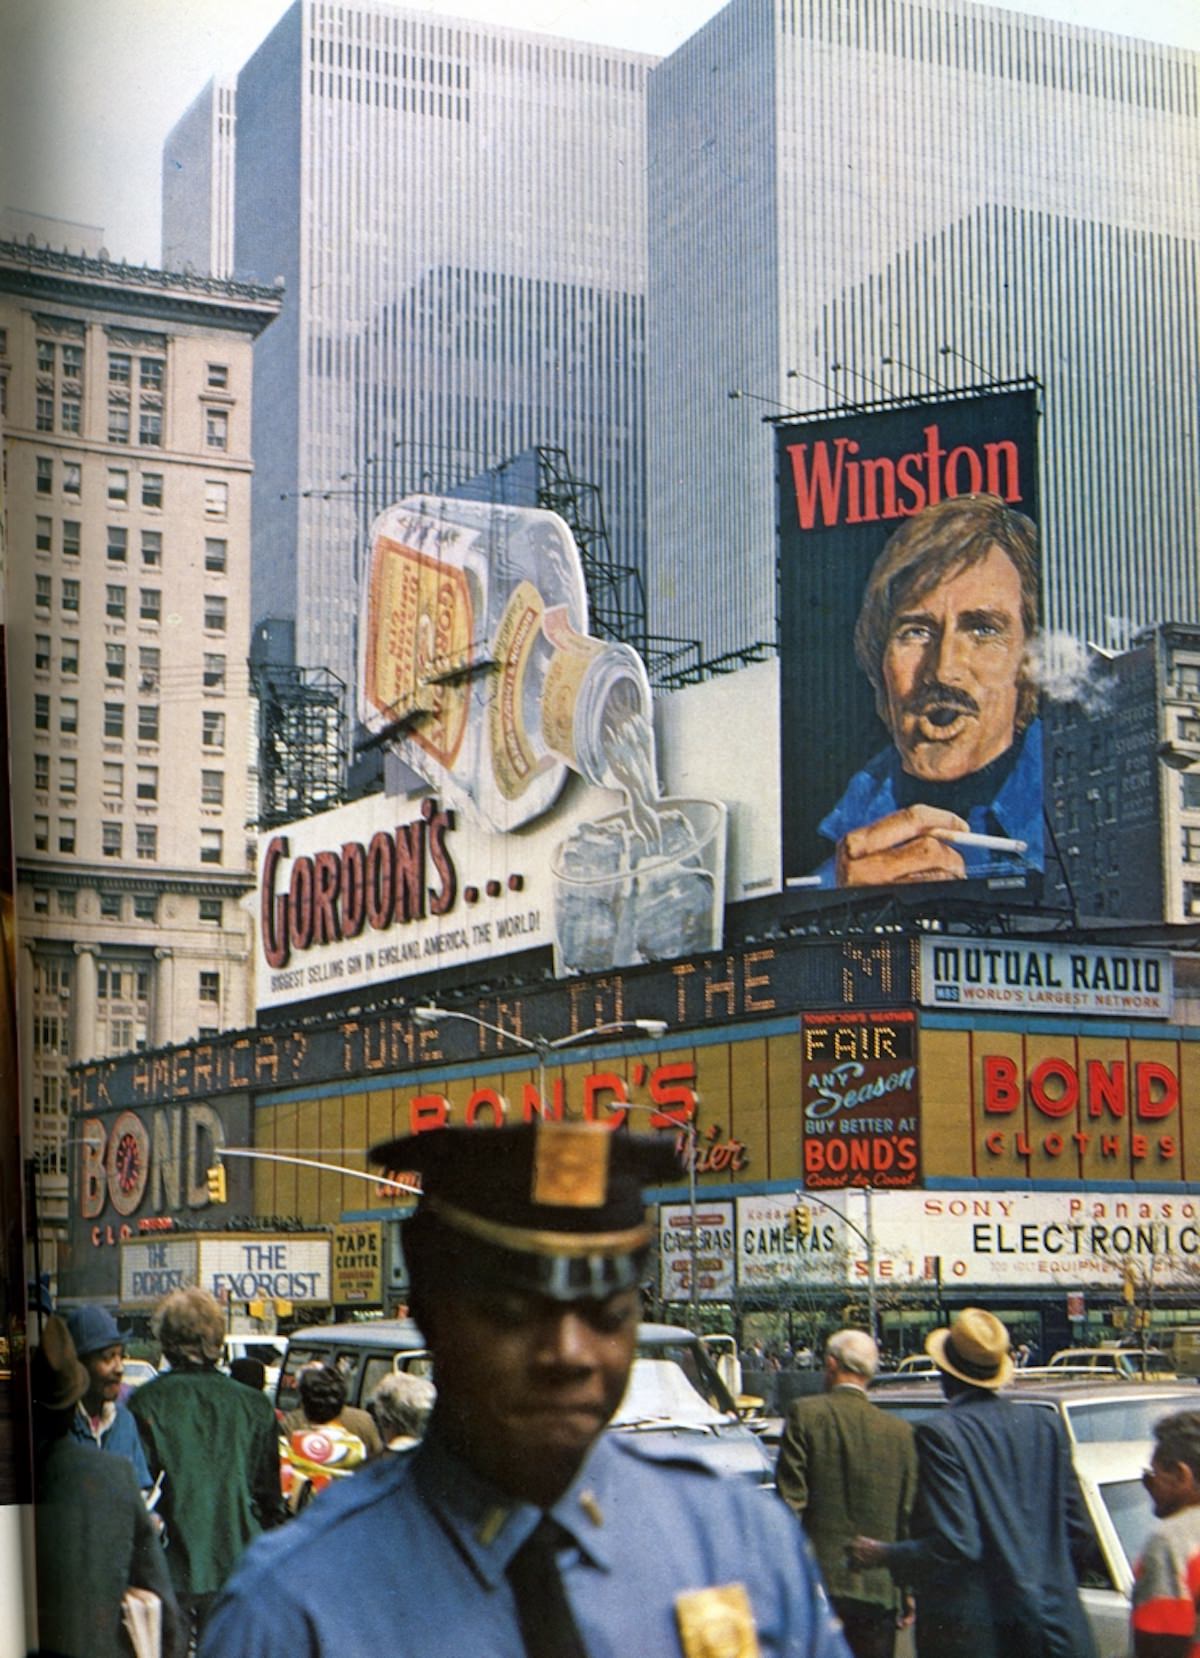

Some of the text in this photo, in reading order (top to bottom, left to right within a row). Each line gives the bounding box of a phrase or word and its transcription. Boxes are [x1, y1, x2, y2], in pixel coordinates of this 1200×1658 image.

[786, 423, 1022, 530] Winston
[270, 969, 305, 993] BIGGEST
[308, 959, 344, 985] SELLING
[347, 954, 363, 976] GIN
[365, 952, 375, 972] IN
[472, 922, 492, 945] THE
[497, 910, 541, 940] WORLD!
[933, 946, 1161, 993] MUTUAL RADIO
[339, 1017, 444, 1073] TUNE
[671, 948, 776, 1023] THE
[963, 985, 1025, 1002] WORLD'S
[1028, 991, 1091, 1007] LARGEST
[1095, 995, 1161, 1010] NETWORK
[805, 1026, 897, 1061] FAIR
[804, 1061, 917, 1119] Season
[807, 1072, 850, 1089] ANY
[981, 1055, 1180, 1120] BOND
[804, 1118, 918, 1135] BUY BETTER AT
[81, 1101, 226, 1219] BOND
[804, 1135, 917, 1174] BOND'S
[985, 1131, 1177, 1162] CLOTHES
[924, 1199, 1013, 1217] SONY
[335, 1233, 378, 1253] TAPE
[972, 1223, 1200, 1255] ELECTRONIC
[241, 1244, 288, 1270] THE
[335, 1253, 379, 1269] CENTER
[212, 1272, 321, 1299] EXORCIST
